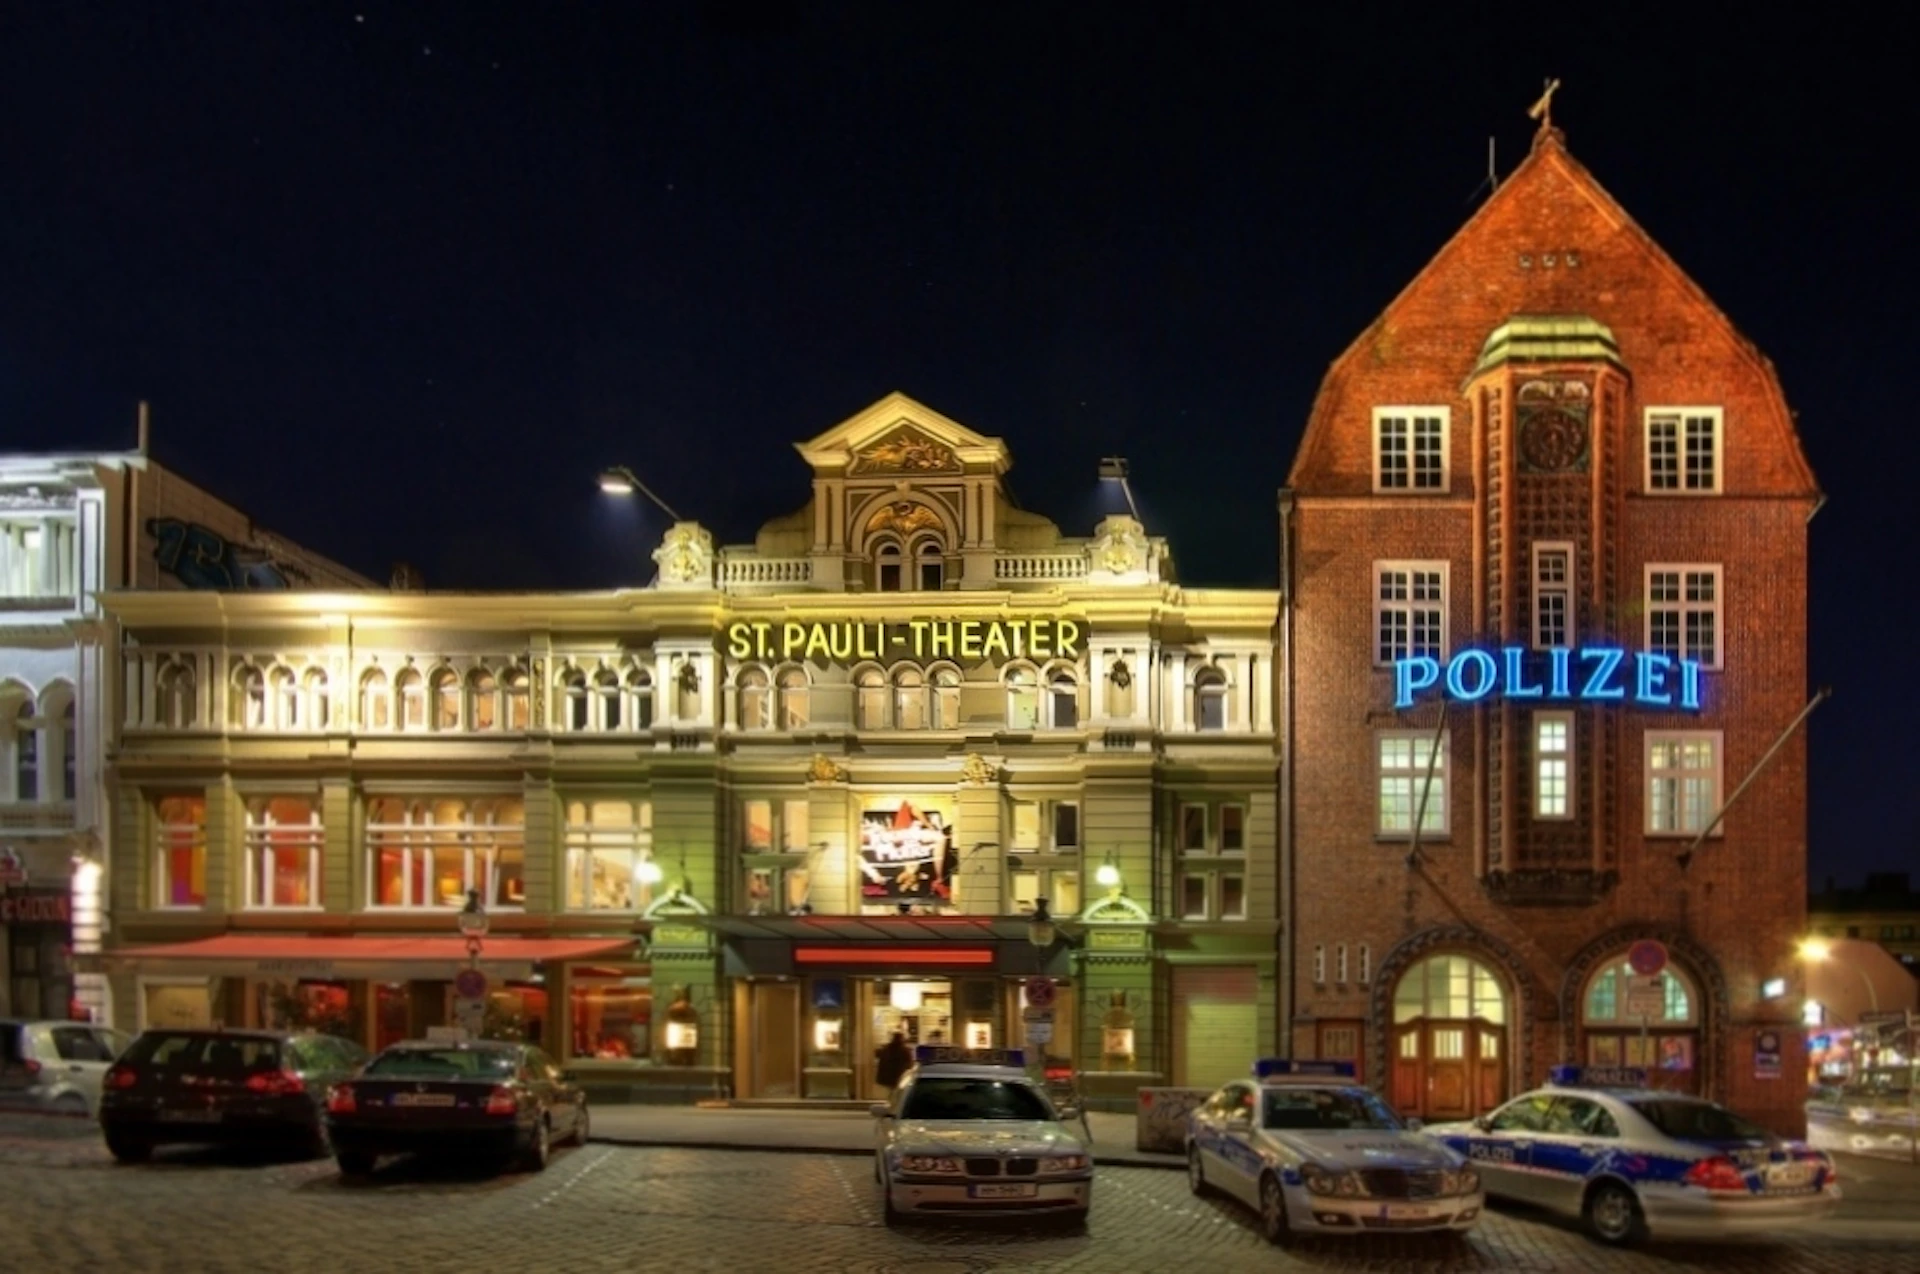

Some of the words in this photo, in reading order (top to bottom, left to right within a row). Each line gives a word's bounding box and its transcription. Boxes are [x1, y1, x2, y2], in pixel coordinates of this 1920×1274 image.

[728, 621, 774, 659] ST.
[782, 620, 1080, 658] PAULI-THEATER
[1394, 647, 1700, 709] POLIZEI
[1468, 1142, 1515, 1162] POLIZEI
